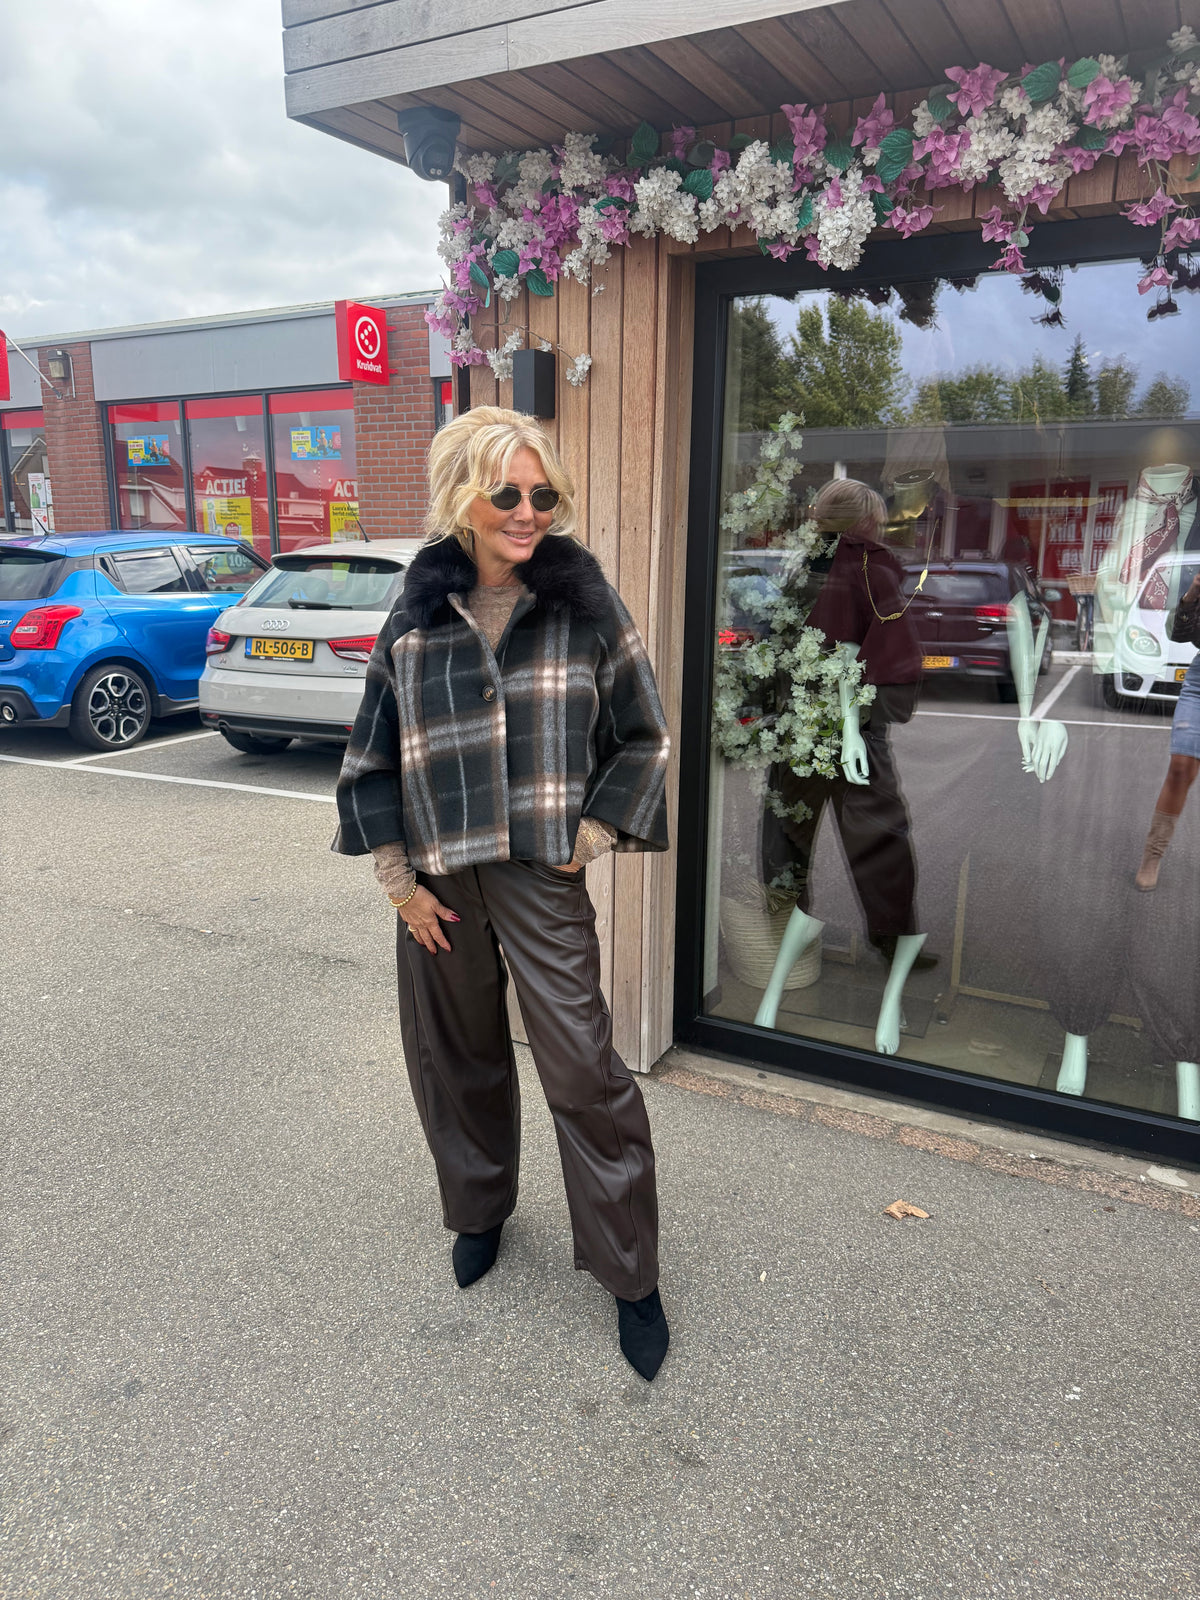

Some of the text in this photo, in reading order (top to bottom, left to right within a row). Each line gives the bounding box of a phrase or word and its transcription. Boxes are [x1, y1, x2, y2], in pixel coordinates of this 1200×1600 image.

[356, 358, 383, 374] Kruidvat
[205, 477, 248, 495] ACTIE!
[255, 640, 309, 657] RL-506-B
